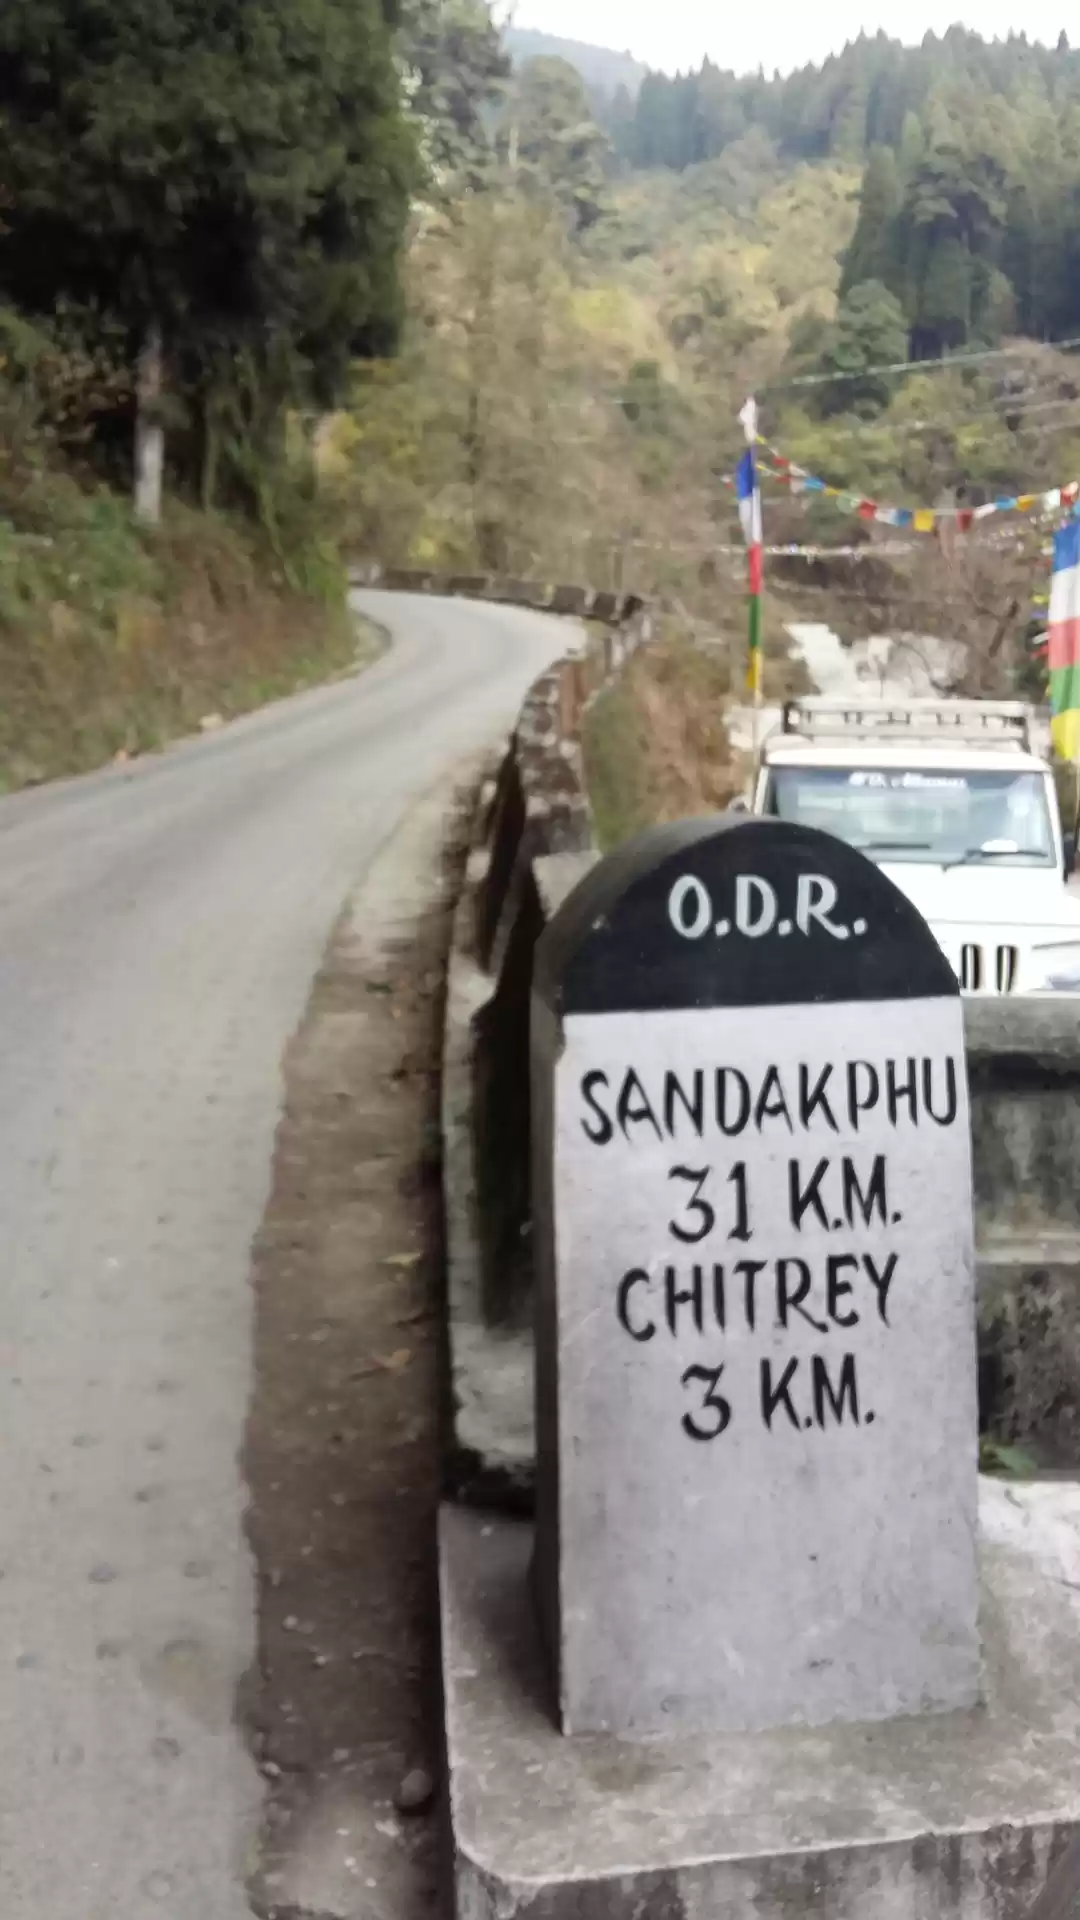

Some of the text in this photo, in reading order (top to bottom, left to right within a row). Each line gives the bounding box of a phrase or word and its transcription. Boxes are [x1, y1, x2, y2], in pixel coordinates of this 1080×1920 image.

[668, 874, 868, 940] O.D.R.
[580, 1056, 958, 1146] SANDAKPHU
[668, 1153, 903, 1244] 31 K.M.
[617, 1252, 899, 1343] CHITREY
[681, 1352, 876, 1442] 3 K.M.
